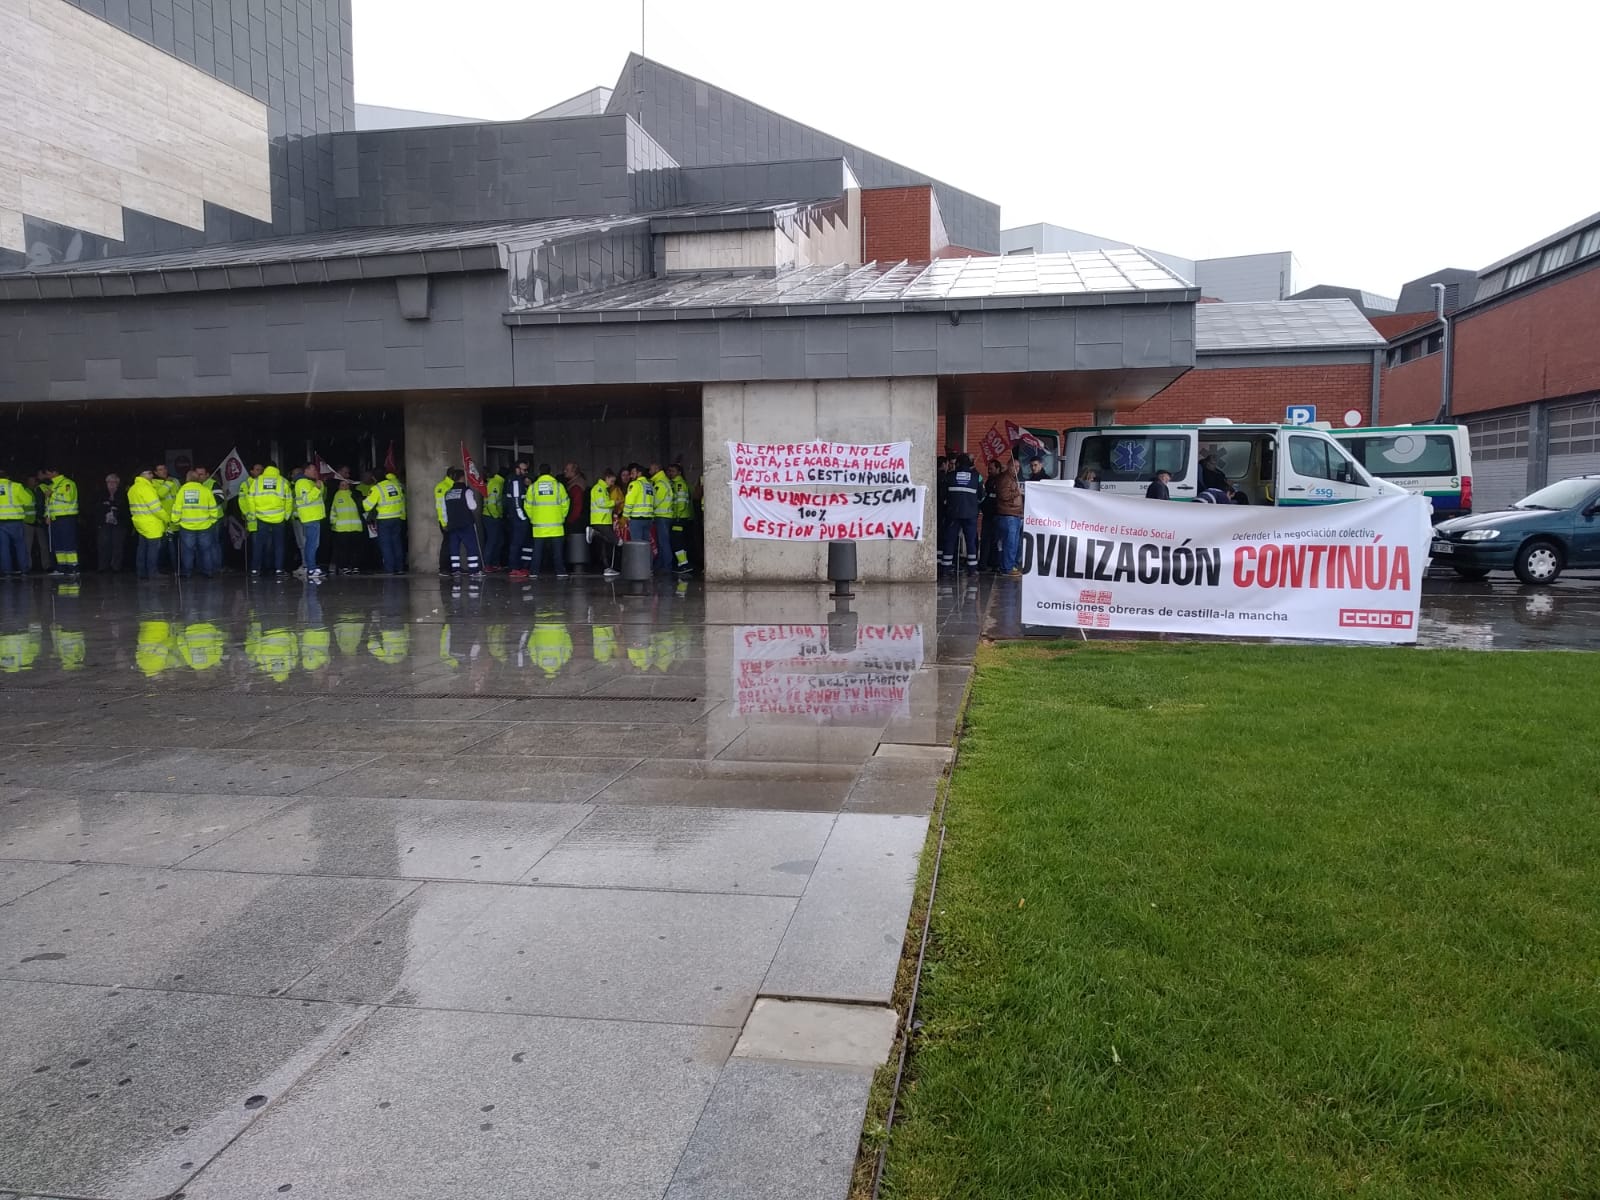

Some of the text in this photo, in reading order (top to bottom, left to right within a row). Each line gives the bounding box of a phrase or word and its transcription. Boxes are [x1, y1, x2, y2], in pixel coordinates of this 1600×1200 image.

[1293, 409, 1310, 425] P
[736, 443, 753, 455] AL
[849, 446, 869, 456] NO
[873, 445, 892, 456] LE
[784, 457, 800, 468] SE
[803, 456, 840, 468] ACABA
[843, 458, 860, 469] LA
[863, 457, 905, 471] HUCHA
[735, 467, 780, 483] MEJOR
[785, 470, 805, 482] LA
[738, 484, 917, 506] AMBULANCIAS SESCAM
[1315, 488, 1334, 498] ssg
[797, 507, 827, 521] 100%
[1025, 516, 1176, 540] derechos Defender el Estado Social
[1231, 527, 1376, 541] Defender la negociación colectiva
[1232, 534, 1411, 591] CONTINÚA
[1036, 600, 1105, 613] comisiones
[1108, 603, 1155, 616] obreras
[1158, 606, 1173, 617] de
[1238, 610, 1289, 621] mancha
